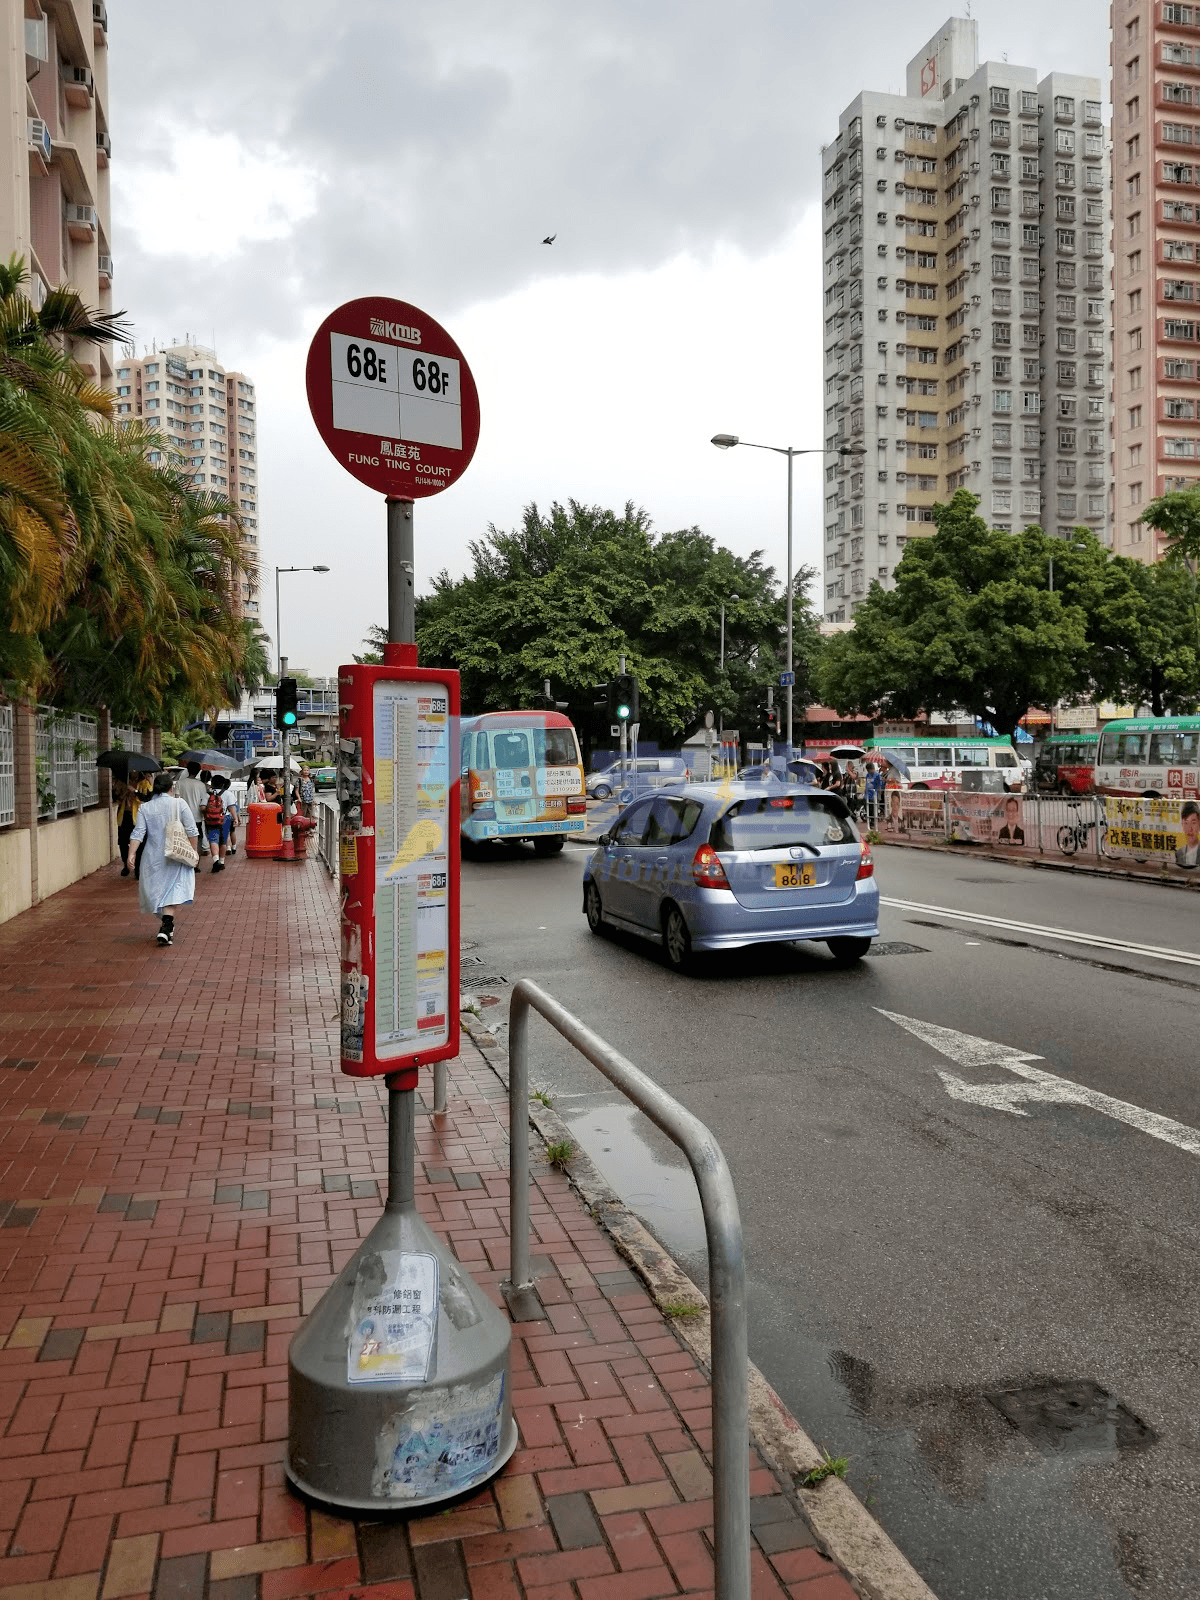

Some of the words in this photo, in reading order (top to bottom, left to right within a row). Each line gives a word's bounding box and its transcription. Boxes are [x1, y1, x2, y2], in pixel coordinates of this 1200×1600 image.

[385, 321, 421, 344] KMB
[346, 343, 387, 384] 68E
[412, 357, 449, 396] 68F
[379, 440, 421, 461] 鳳庭苑
[348, 452, 380, 466] FUNG
[384, 458, 411, 471] TING
[415, 463, 452, 478] COURT
[432, 700, 446, 712] 68E
[432, 875, 446, 888] 68F
[782, 874, 810, 886] 8618
